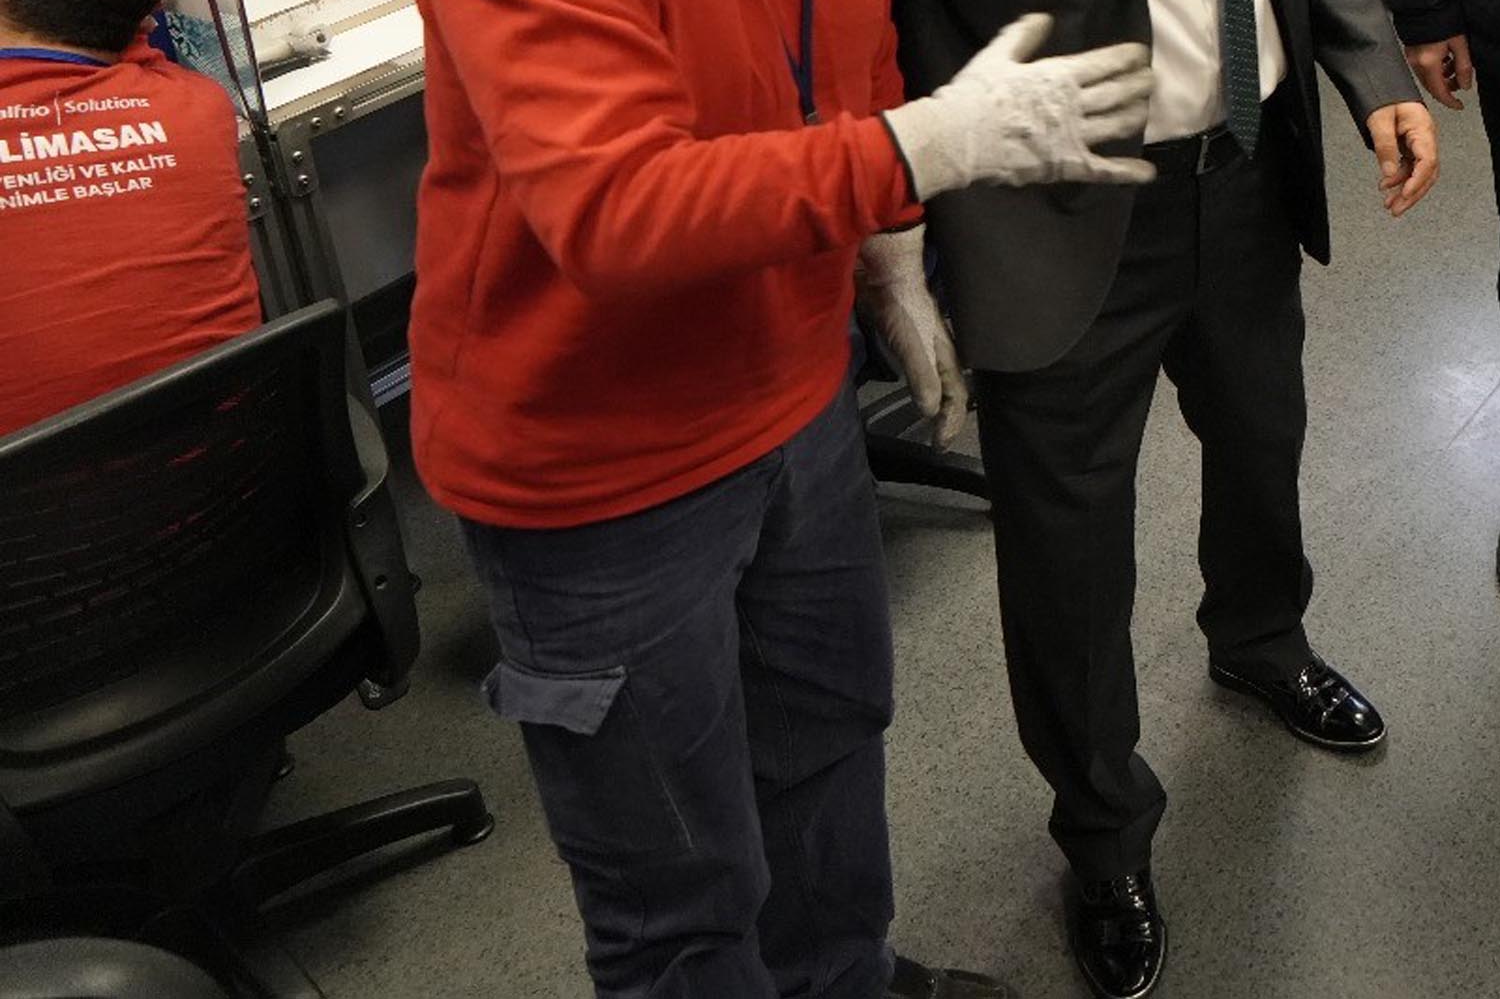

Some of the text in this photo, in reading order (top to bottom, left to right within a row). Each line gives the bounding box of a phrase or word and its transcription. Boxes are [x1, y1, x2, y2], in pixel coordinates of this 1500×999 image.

[64, 96, 151, 114] Solutions
[0, 153, 177, 189] ENLİĞİ VE KALİTE
[72, 176, 153, 197] BAŞLAR
